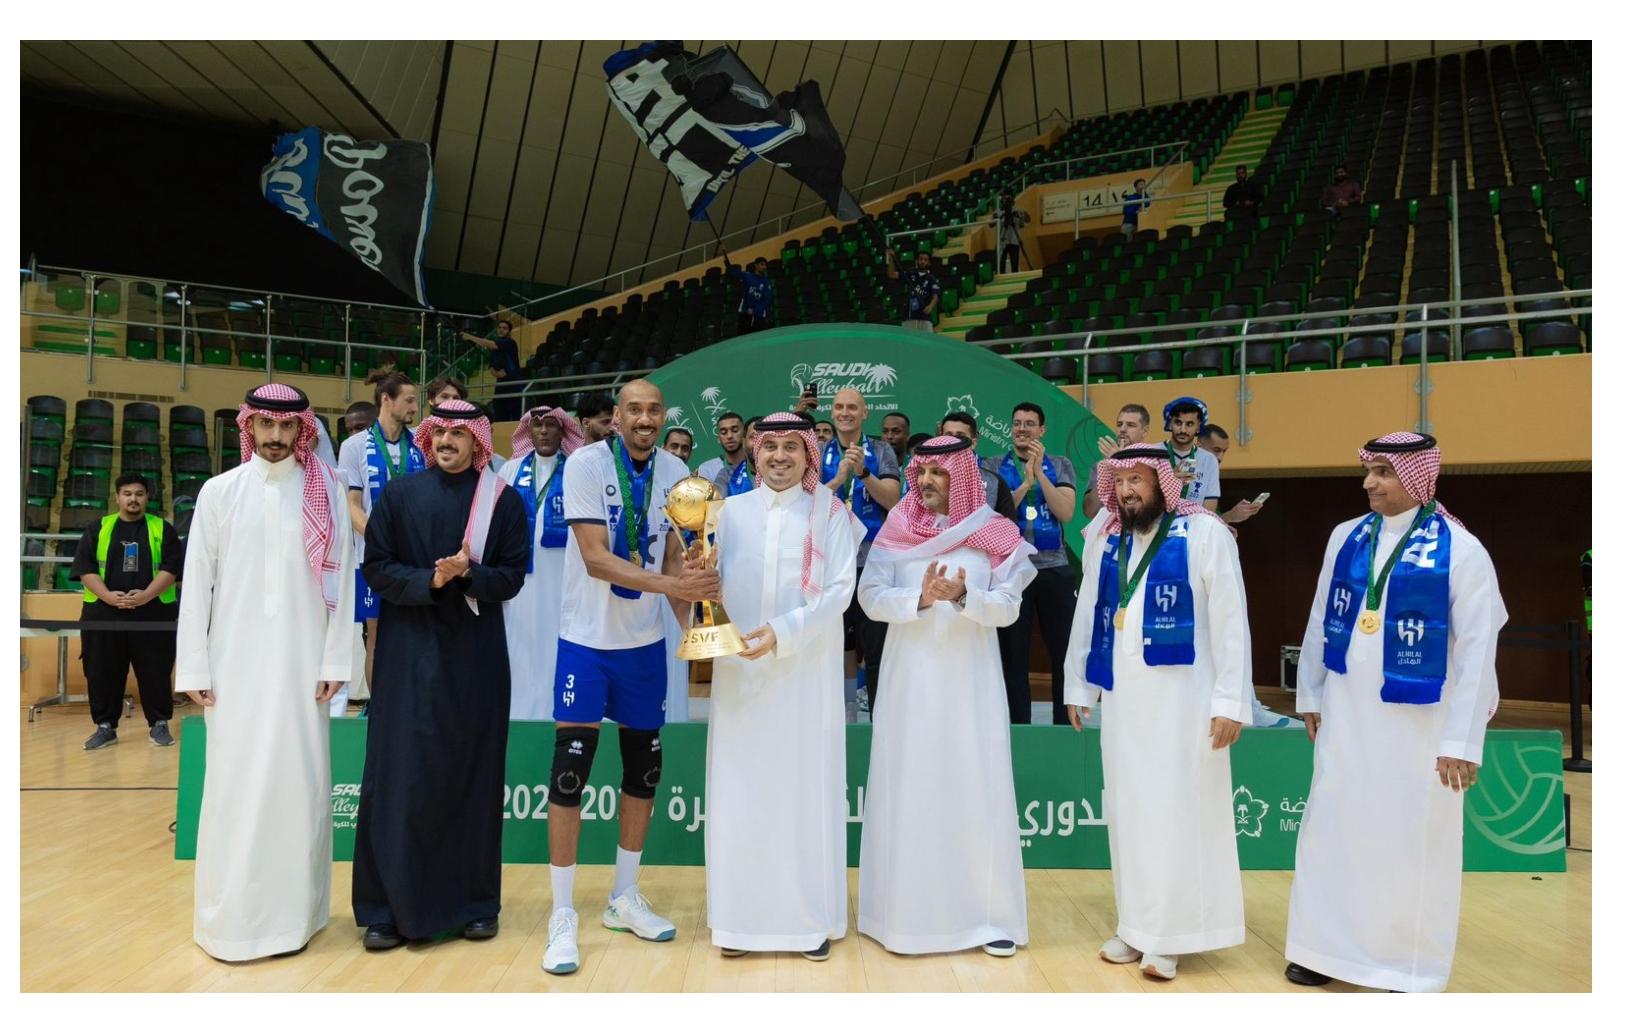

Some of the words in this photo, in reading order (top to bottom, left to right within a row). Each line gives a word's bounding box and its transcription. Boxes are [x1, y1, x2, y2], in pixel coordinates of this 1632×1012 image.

[1083, 193, 1103, 207] 14
[812, 362, 871, 377] SAUDI
[978, 426, 1008, 449] Ministry
[565, 674, 575, 688] 3
